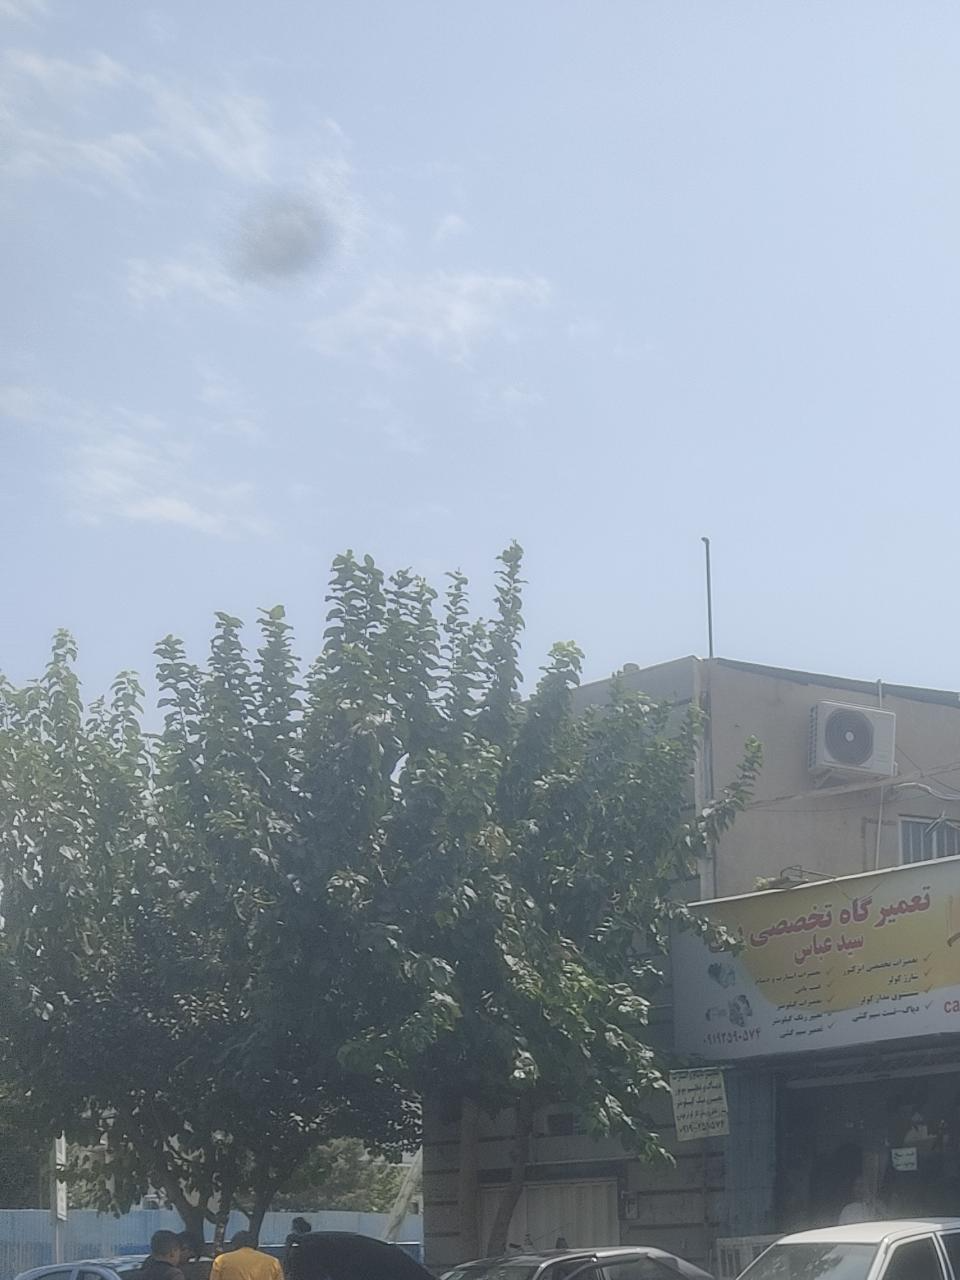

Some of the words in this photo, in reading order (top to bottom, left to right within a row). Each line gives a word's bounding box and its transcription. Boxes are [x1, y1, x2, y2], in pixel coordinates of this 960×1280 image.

[750, 904, 833, 948] تخصصی
[794, 933, 832, 965] عباس
[836, 934, 864, 956] سید
